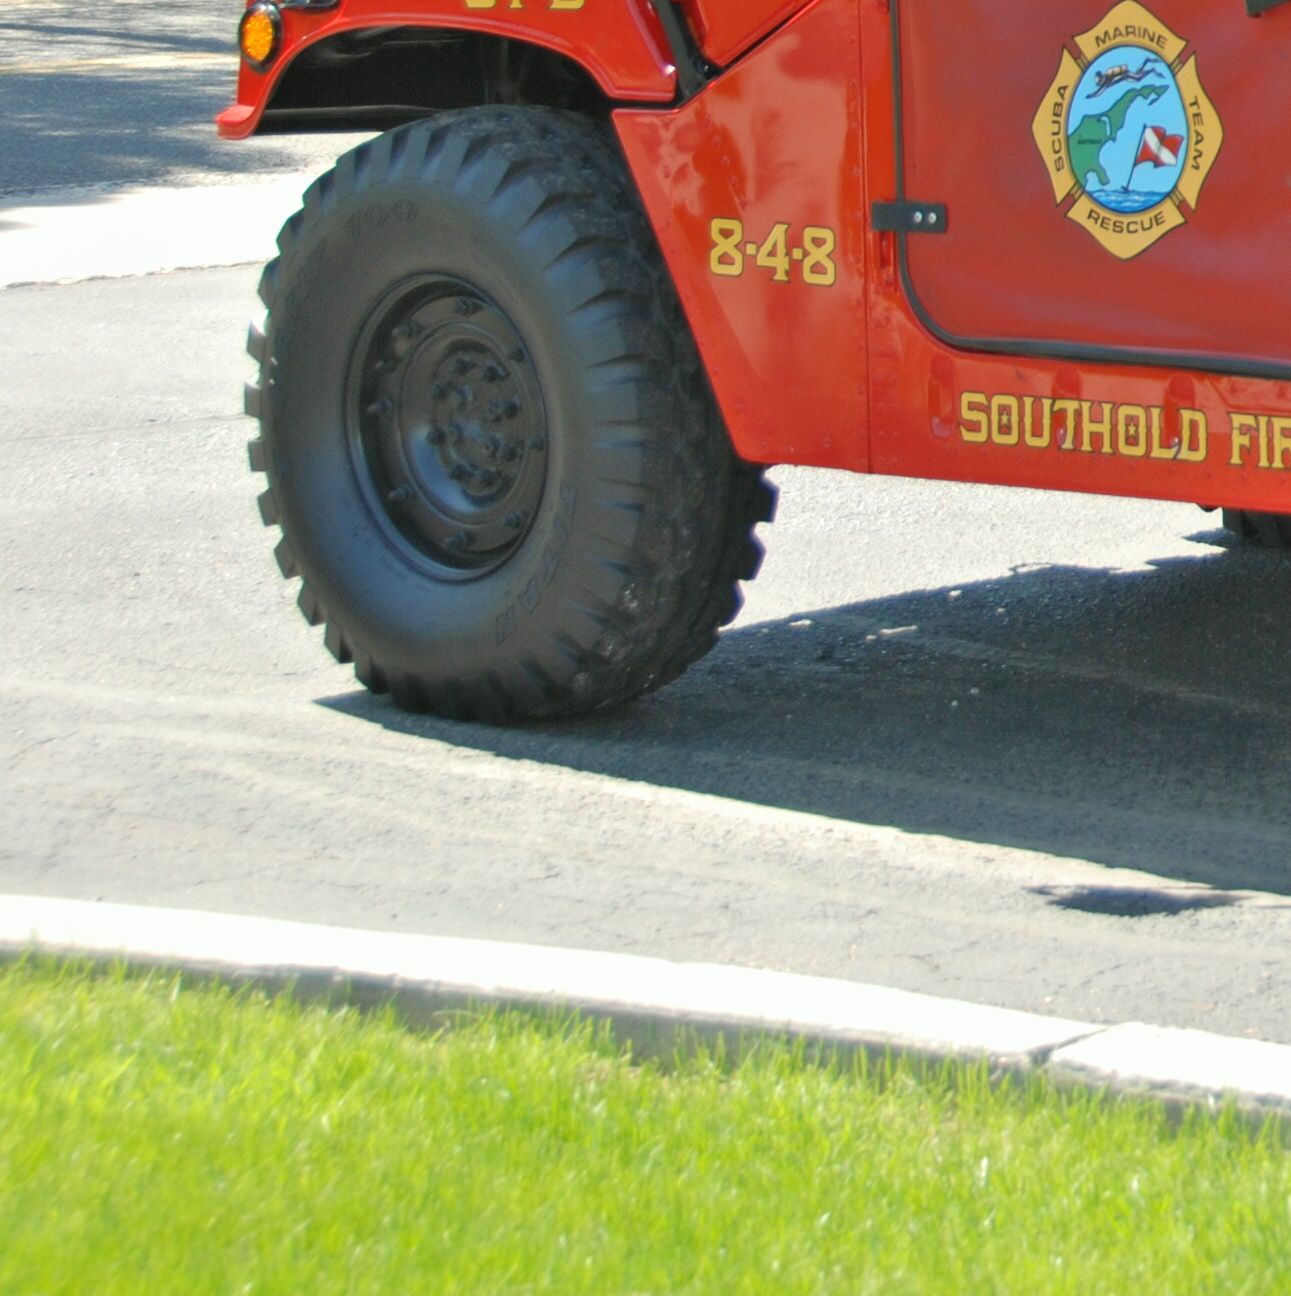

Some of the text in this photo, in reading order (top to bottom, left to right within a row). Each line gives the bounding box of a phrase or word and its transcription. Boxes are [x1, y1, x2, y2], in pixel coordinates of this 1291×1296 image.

[1094, 24, 1169, 50] MARINE
[1051, 84, 1070, 173] SCUBA
[1187, 95, 1205, 171] TEAM
[710, 216, 837, 286] 8-4-8
[1086, 208, 1167, 235] RESCUE
[958, 391, 1208, 463] SOUTHOLD
